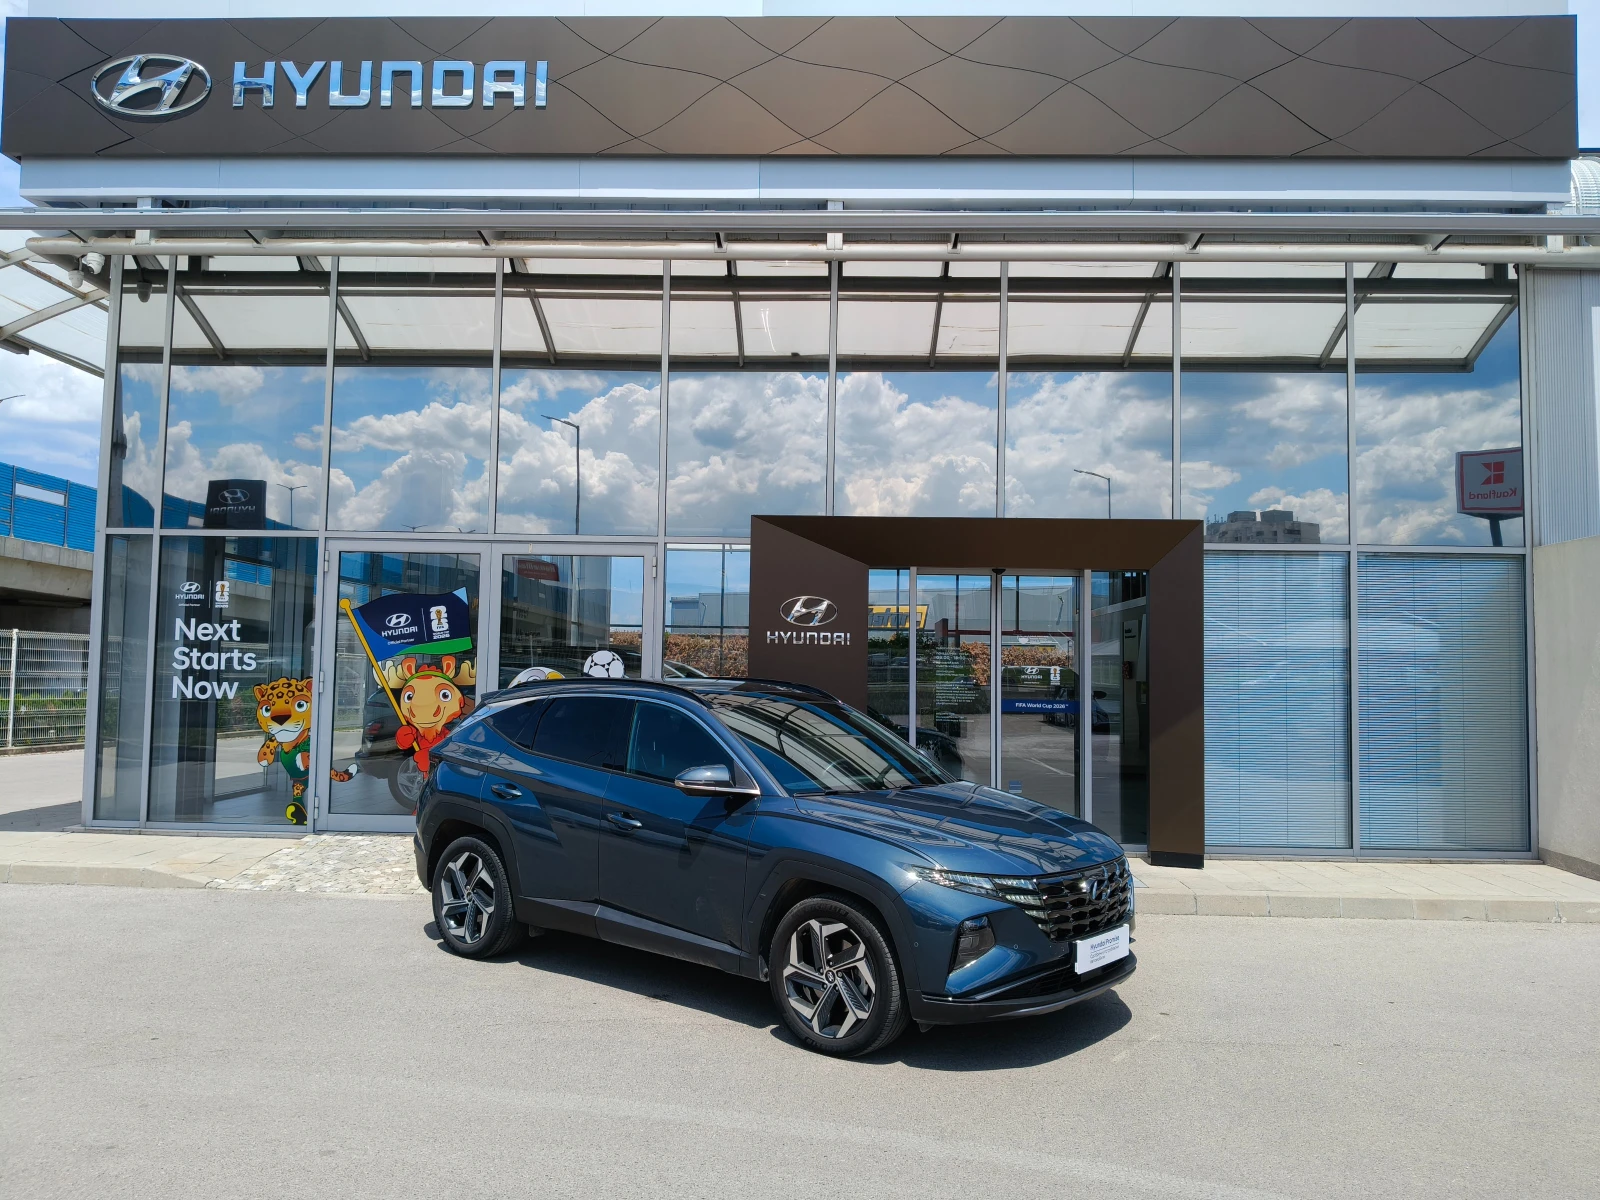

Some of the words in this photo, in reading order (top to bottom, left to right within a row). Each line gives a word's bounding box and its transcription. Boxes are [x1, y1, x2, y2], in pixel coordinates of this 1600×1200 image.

[232, 60, 548, 107] HYUNDAI
[174, 618, 241, 641] Next
[381, 626, 418, 638] HYUNDAI
[766, 631, 851, 645] HYUNDAI
[172, 646, 257, 671] Starts
[172, 675, 239, 700] Now
